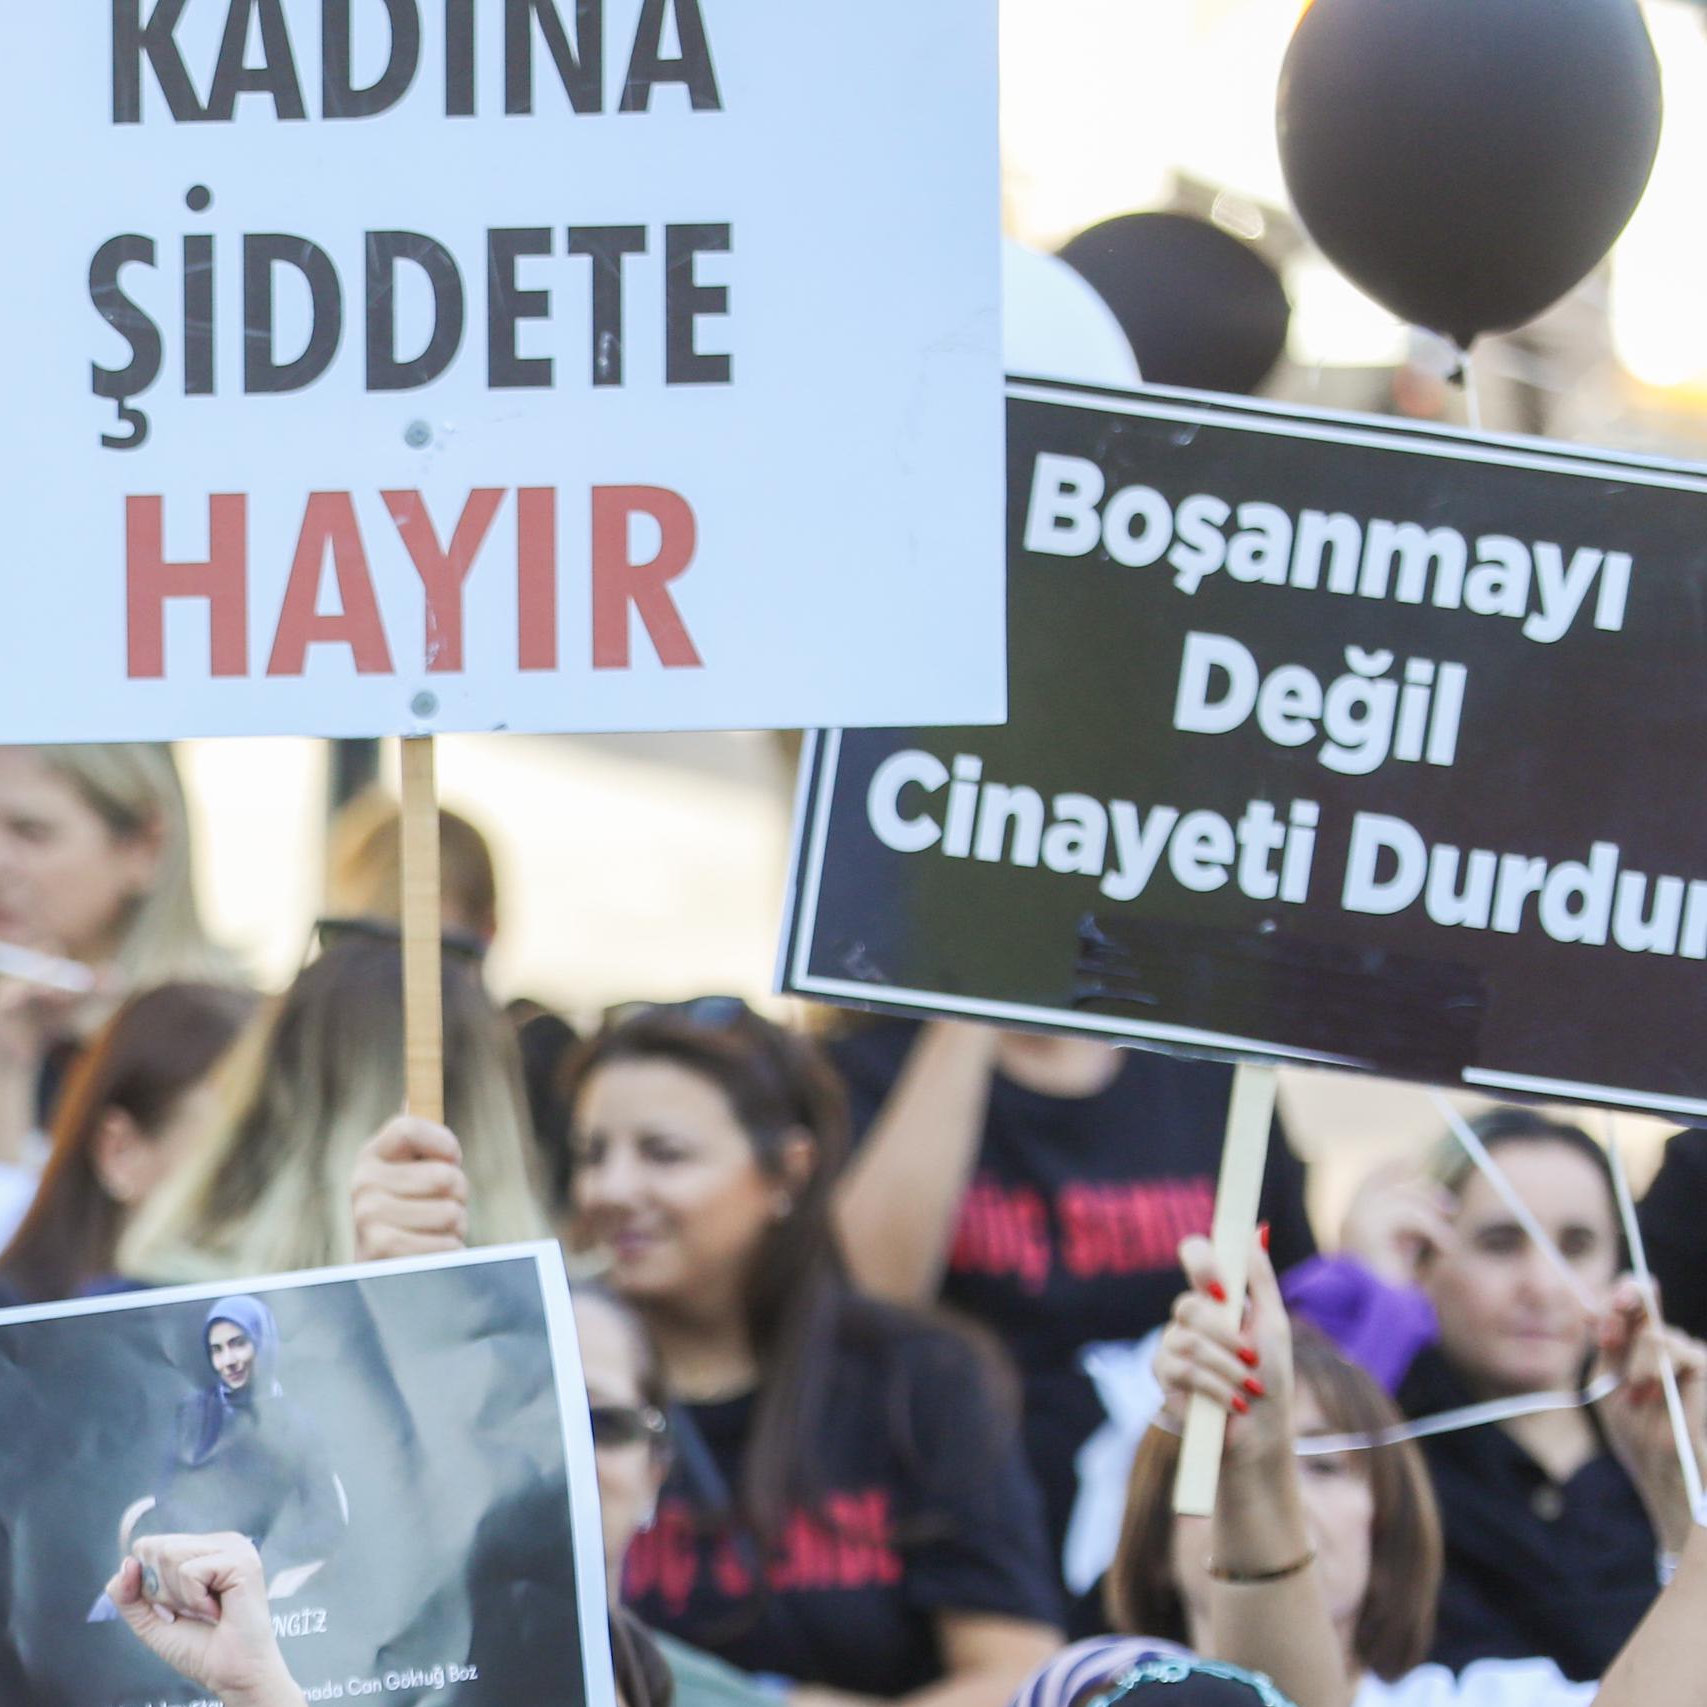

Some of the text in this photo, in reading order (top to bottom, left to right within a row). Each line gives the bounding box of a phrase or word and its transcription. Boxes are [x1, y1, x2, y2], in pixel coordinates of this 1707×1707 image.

[110, 0, 723, 126] KADINA
[88, 184, 734, 451] ŞİDDETE
[124, 483, 704, 679] HAYIR
[1024, 452, 1633, 644] Boşanmayı
[1173, 631, 1468, 776] Değil
[865, 750, 1320, 902] Cinayeti
[272, 1606, 328, 1638] NGİZ
[347, 1679, 383, 1697] Can
[385, 1666, 446, 1692] Göktuğ
[448, 1662, 479, 1684] Boz
